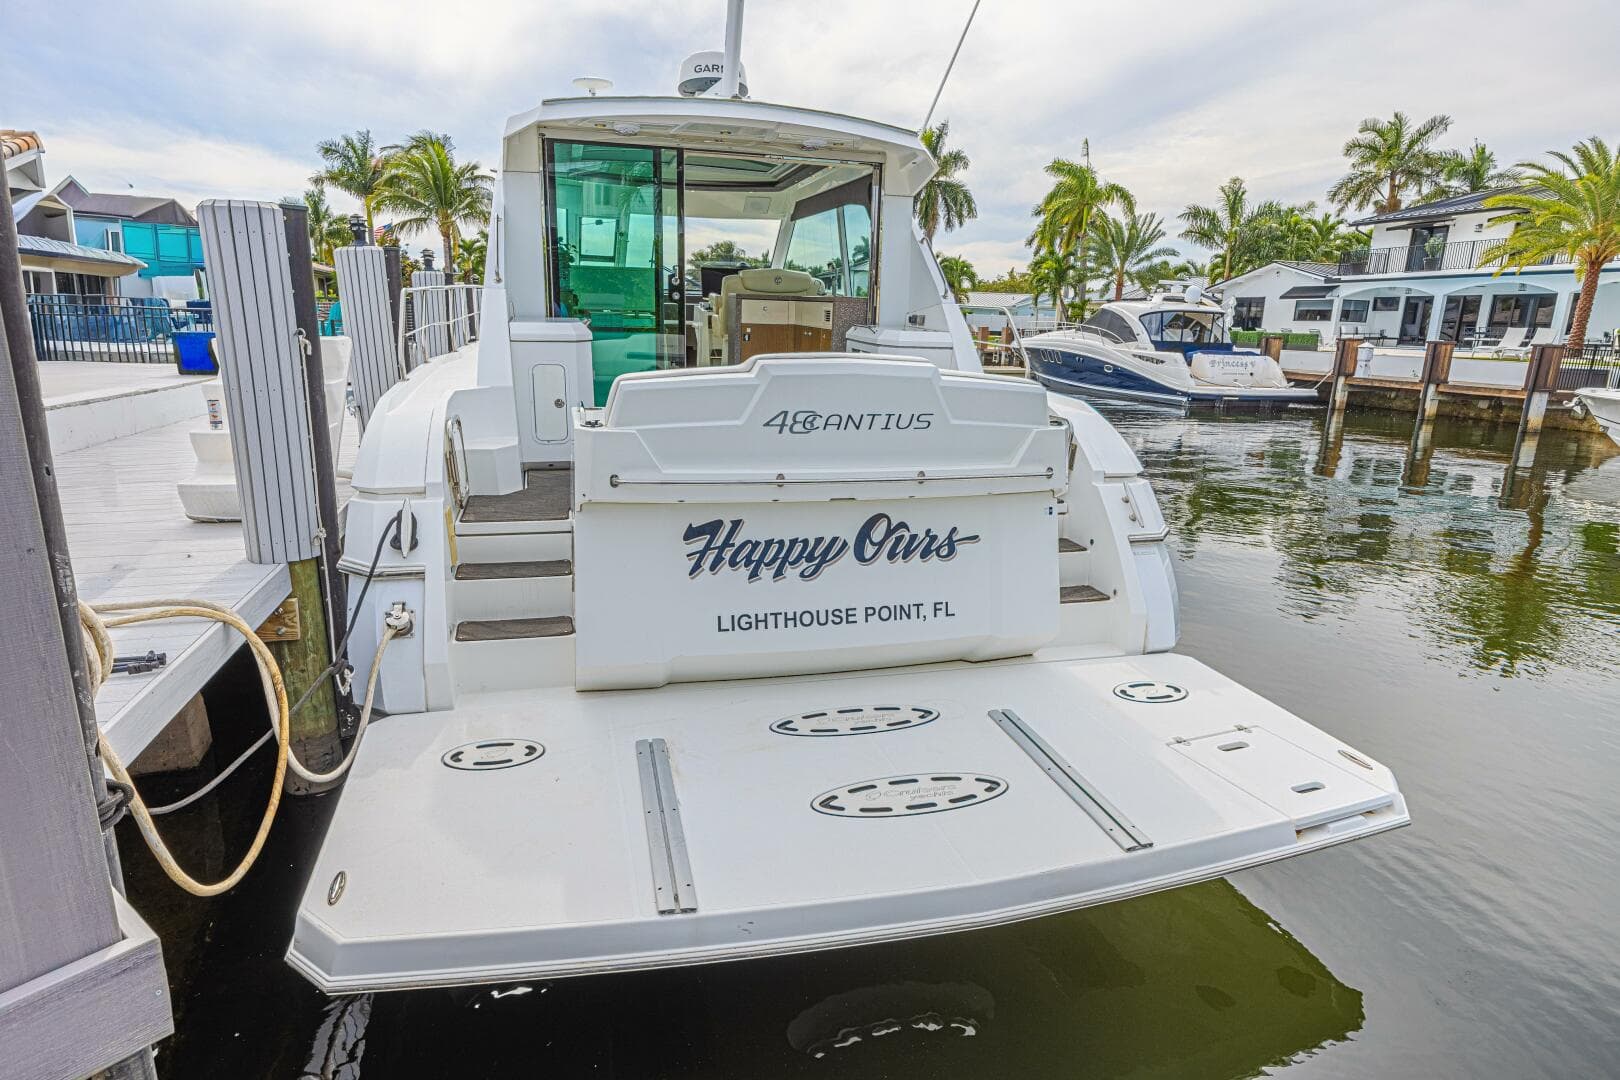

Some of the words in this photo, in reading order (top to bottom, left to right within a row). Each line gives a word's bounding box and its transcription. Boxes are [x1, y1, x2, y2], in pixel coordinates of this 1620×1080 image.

[802, 413, 935, 431] CANTIUS
[683, 518, 848, 583] Happy
[853, 513, 981, 566] Ours
[717, 608, 858, 632] LIGHTHOUSE
[864, 603, 928, 622] POINT,
[933, 601, 955, 618] FL
